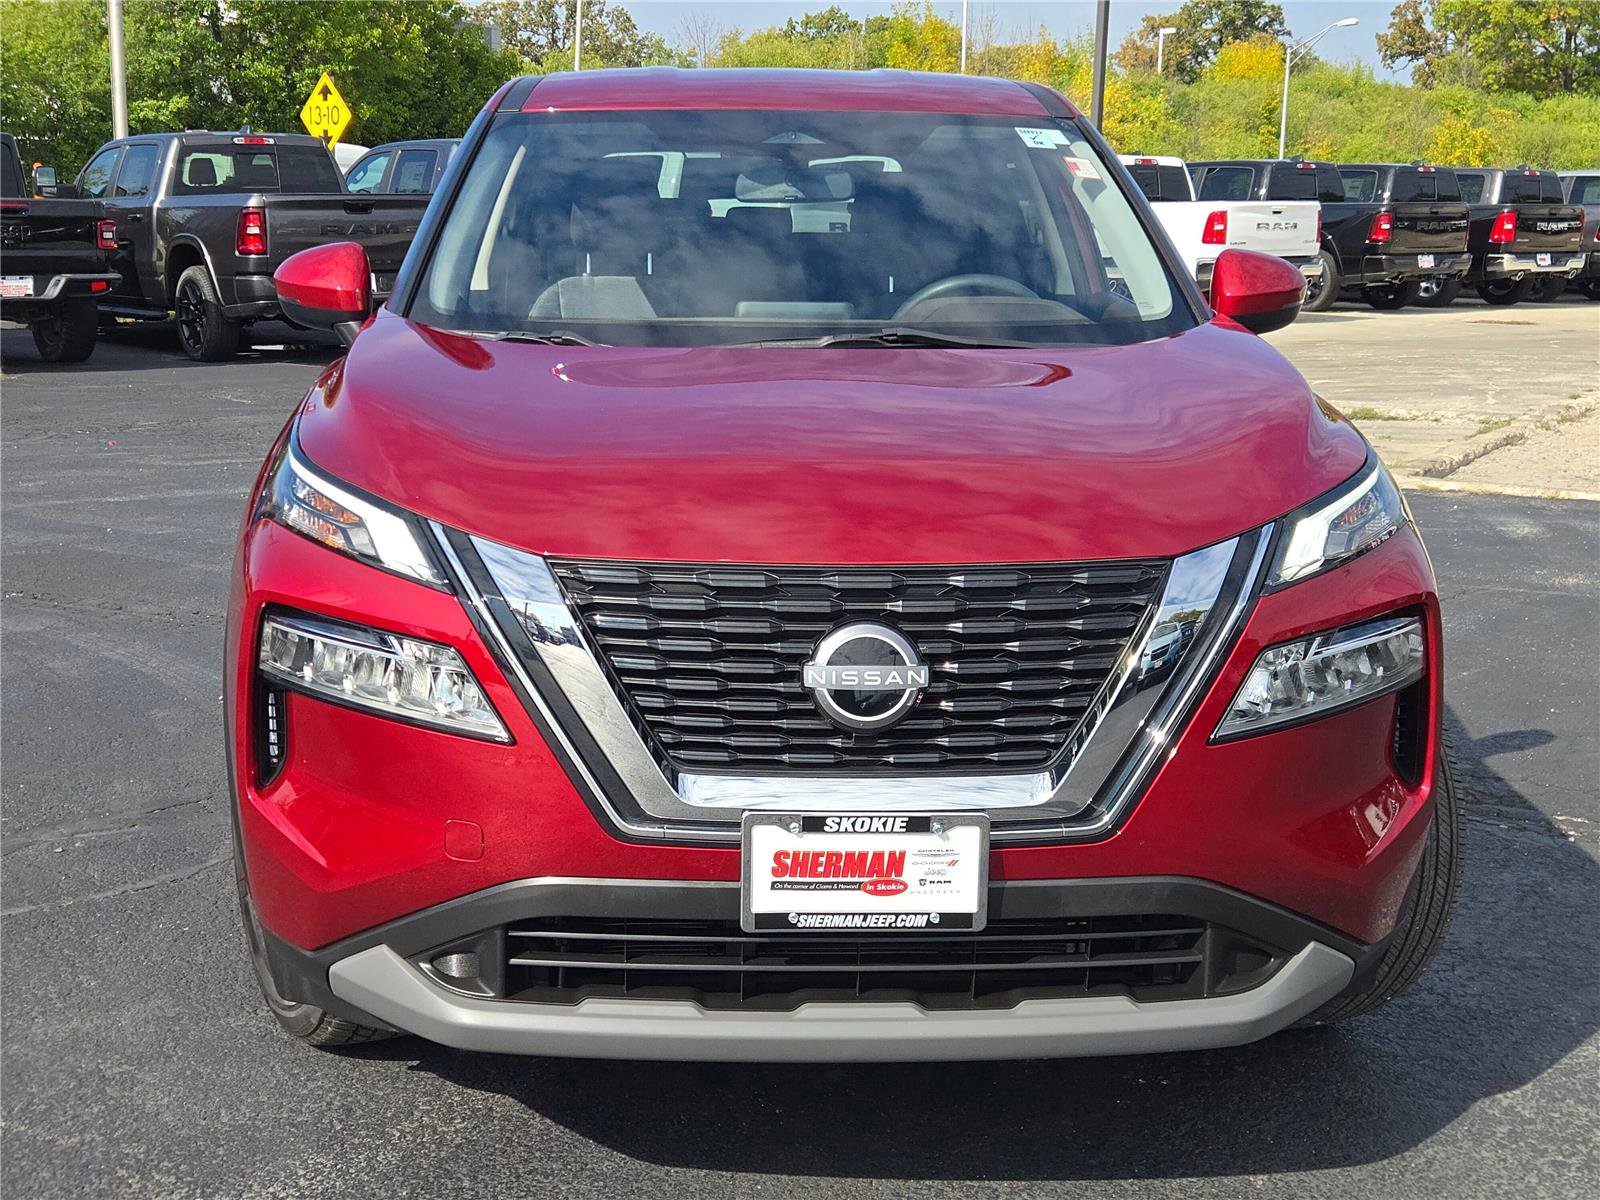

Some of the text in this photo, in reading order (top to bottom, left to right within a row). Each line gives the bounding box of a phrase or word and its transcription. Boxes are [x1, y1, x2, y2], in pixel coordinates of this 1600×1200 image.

[320, 223, 400, 234] RAM
[1255, 222, 1298, 231] RAM
[807, 669, 926, 686] NISSAN
[823, 816, 909, 833] SKOKIE
[771, 849, 906, 878] SHERMAN
[797, 914, 929, 928] SHERMANJEEP.COM
